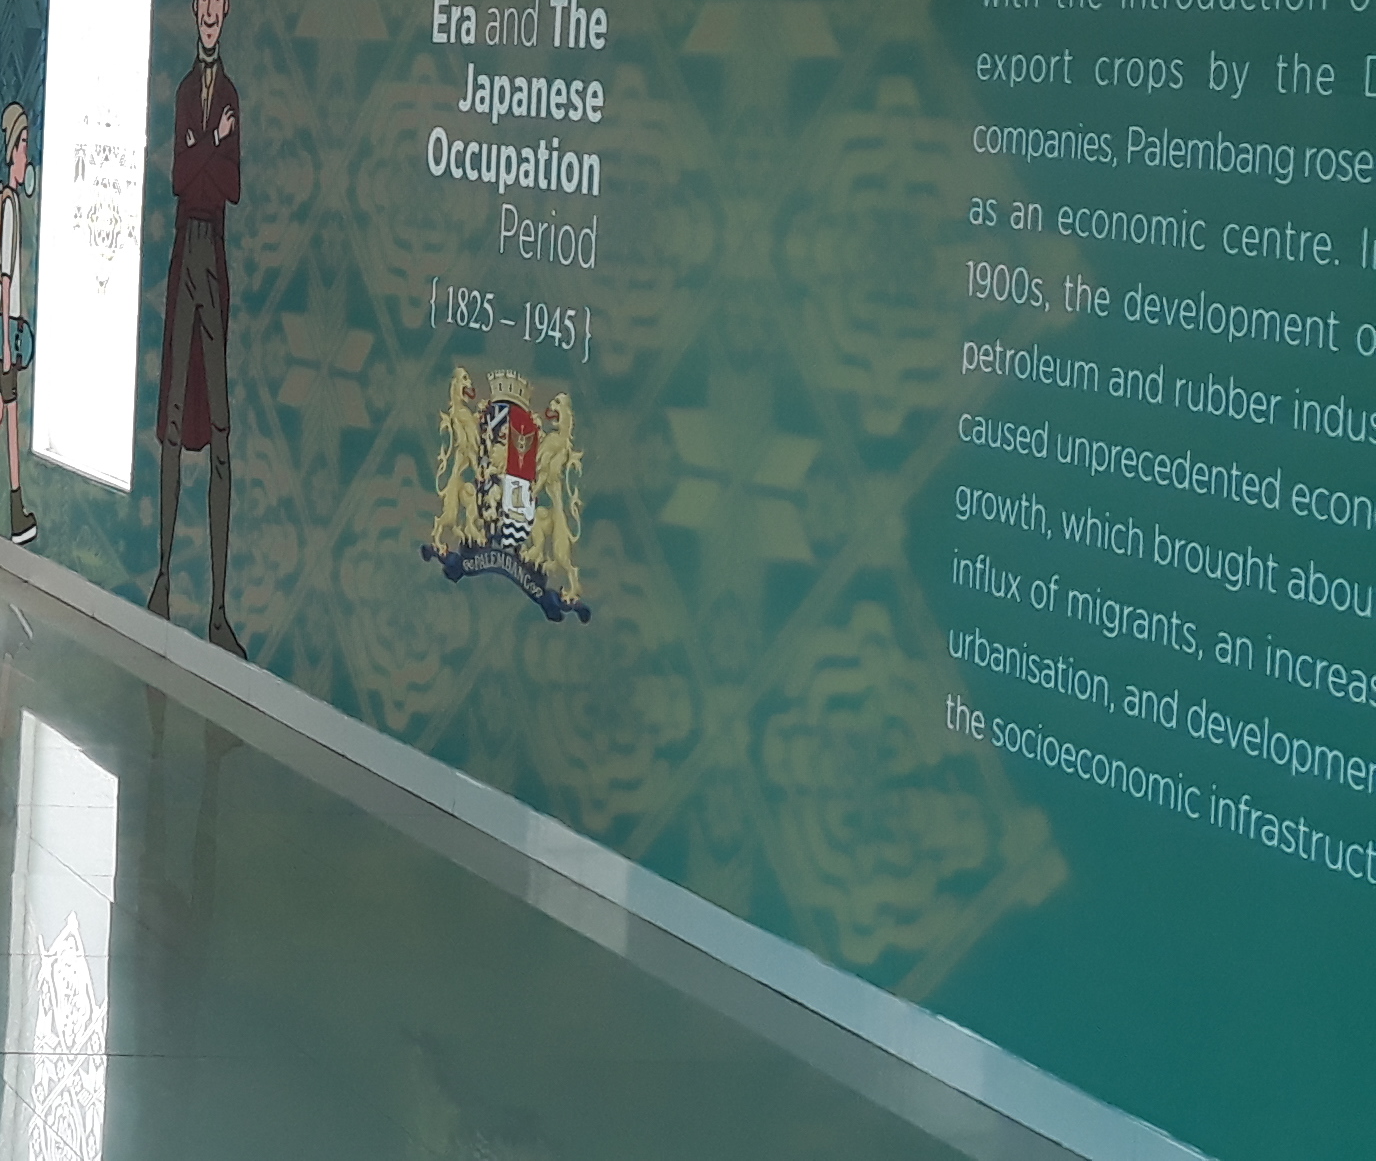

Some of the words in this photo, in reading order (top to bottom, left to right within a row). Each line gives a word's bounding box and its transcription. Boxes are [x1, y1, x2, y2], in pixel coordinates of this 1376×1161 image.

[458, 62, 604, 124] Japanese
[976, 48, 1074, 88] export
[1094, 56, 1184, 94] crops
[1208, 49, 1251, 100] by
[1276, 52, 1335, 96] the
[427, 126, 601, 196] Occupation
[972, 122, 1118, 168] companies,
[1127, 125, 1295, 185] Palembang
[1304, 147, 1374, 184] rose
[499, 203, 597, 269] Period
[969, 197, 998, 227] as
[1010, 201, 1043, 232] an
[1057, 205, 1206, 251] economic
[1222, 220, 1340, 266] centre.
[1361, 227, 1376, 270] I
[965, 260, 1050, 313] 1900s,
[1064, 273, 1111, 317] the
[1123, 282, 1341, 352] development
[961, 338, 1099, 392] petroleum
[1108, 363, 1164, 405] and
[1175, 372, 1283, 425] rubber
[958, 413, 1049, 459] caused
[1057, 434, 1281, 511] unprecedented
[1291, 482, 1376, 531] econ
[955, 485, 1052, 540] growth,
[1061, 507, 1144, 559] which
[1153, 523, 1279, 594] brought
[1287, 559, 1373, 618] abou
[952, 549, 1022, 603] influx
[1030, 574, 1060, 612] of
[1067, 589, 1203, 661] migrants,
[1214, 631, 1253, 671] an
[948, 628, 1115, 714] urbanisation,
[1122, 685, 1179, 729] and
[945, 693, 986, 740] the
[991, 715, 1201, 819] socioeconomic
